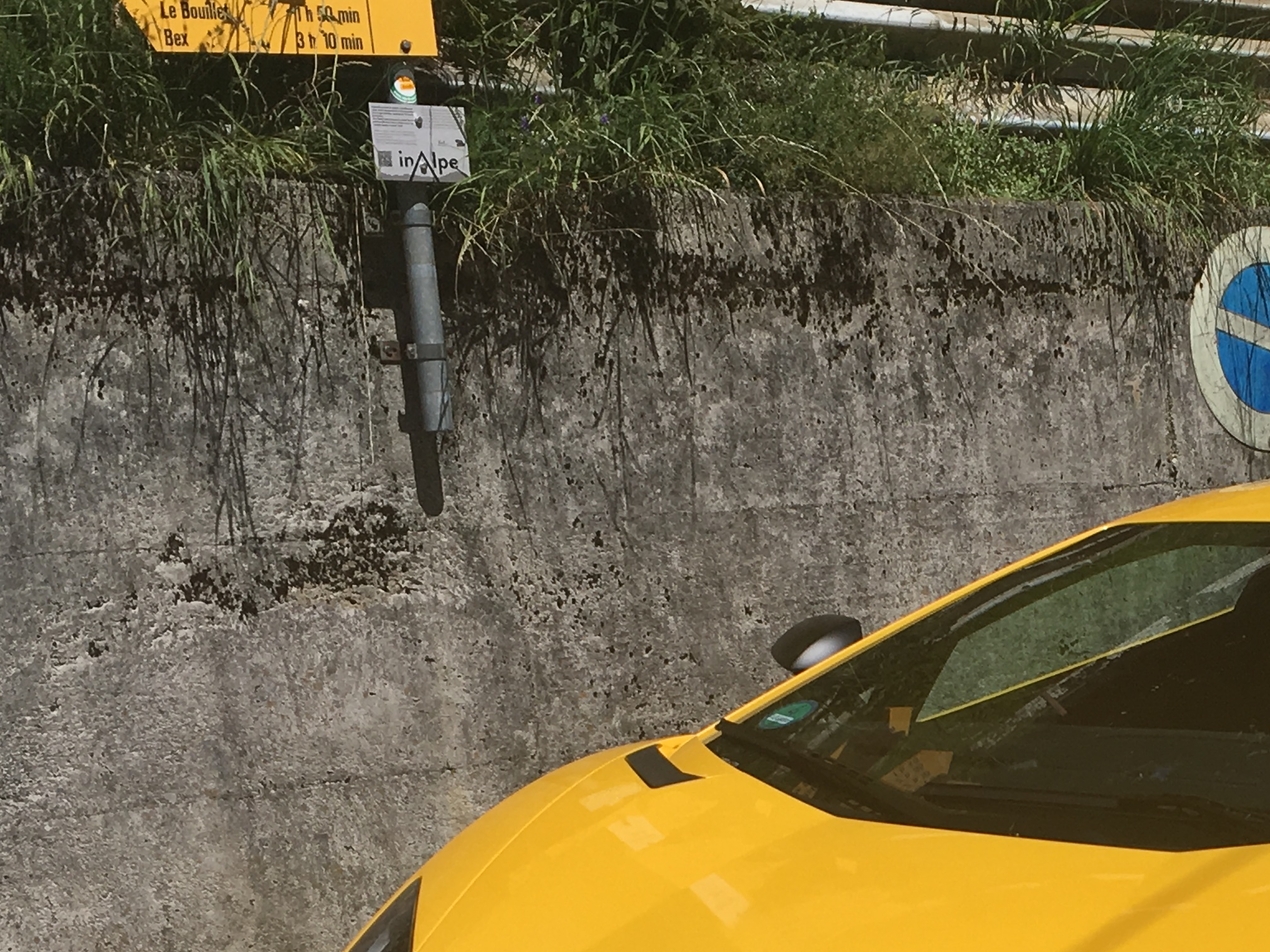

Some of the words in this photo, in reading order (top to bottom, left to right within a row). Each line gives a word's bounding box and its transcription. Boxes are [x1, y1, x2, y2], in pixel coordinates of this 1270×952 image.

[161, 1, 177, 19] Le
[181, 1, 229, 20] Bouillet
[304, 5, 314, 22] h
[338, 6, 361, 23] min
[164, 29, 189, 46] Bex
[297, 32, 305, 49] 3
[308, 32, 317, 49] h
[323, 32, 337, 49] 10
[341, 33, 363, 50] min
